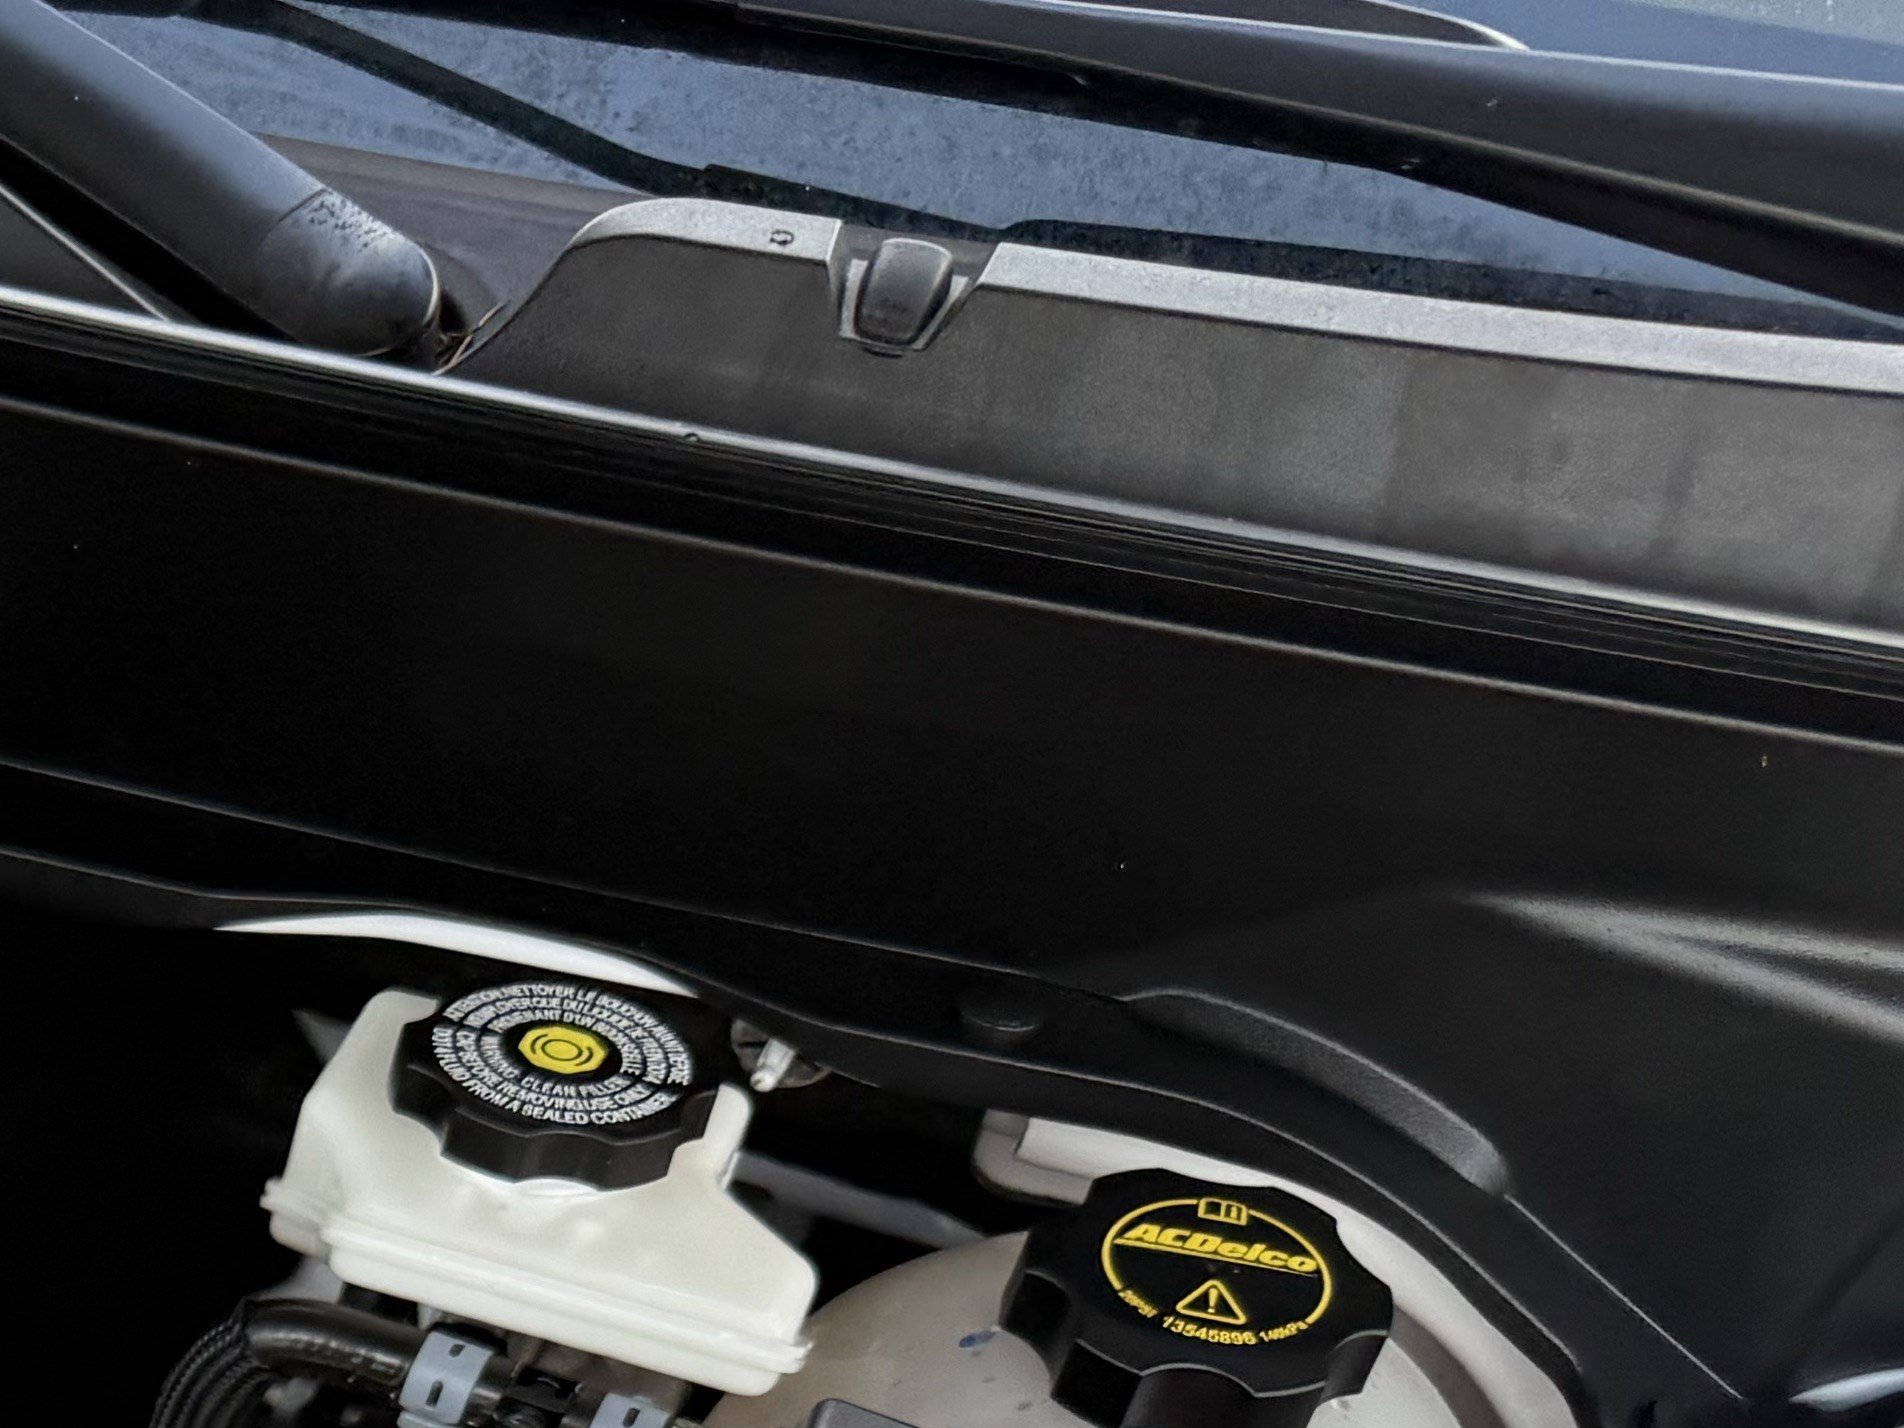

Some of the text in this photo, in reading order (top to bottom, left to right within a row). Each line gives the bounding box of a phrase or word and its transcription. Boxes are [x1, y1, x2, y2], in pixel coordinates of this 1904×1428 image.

[562, 998, 585, 1012] DU
[435, 1053, 474, 1082] FLUID
[458, 1078, 510, 1107] FROM
[503, 1099, 522, 1112] A
[517, 1103, 590, 1124] SEALED
[588, 1090, 678, 1124] CONTAINER
[516, 1076, 579, 1097] CLEAN
[1122, 1223, 1319, 1272] ACDelco
